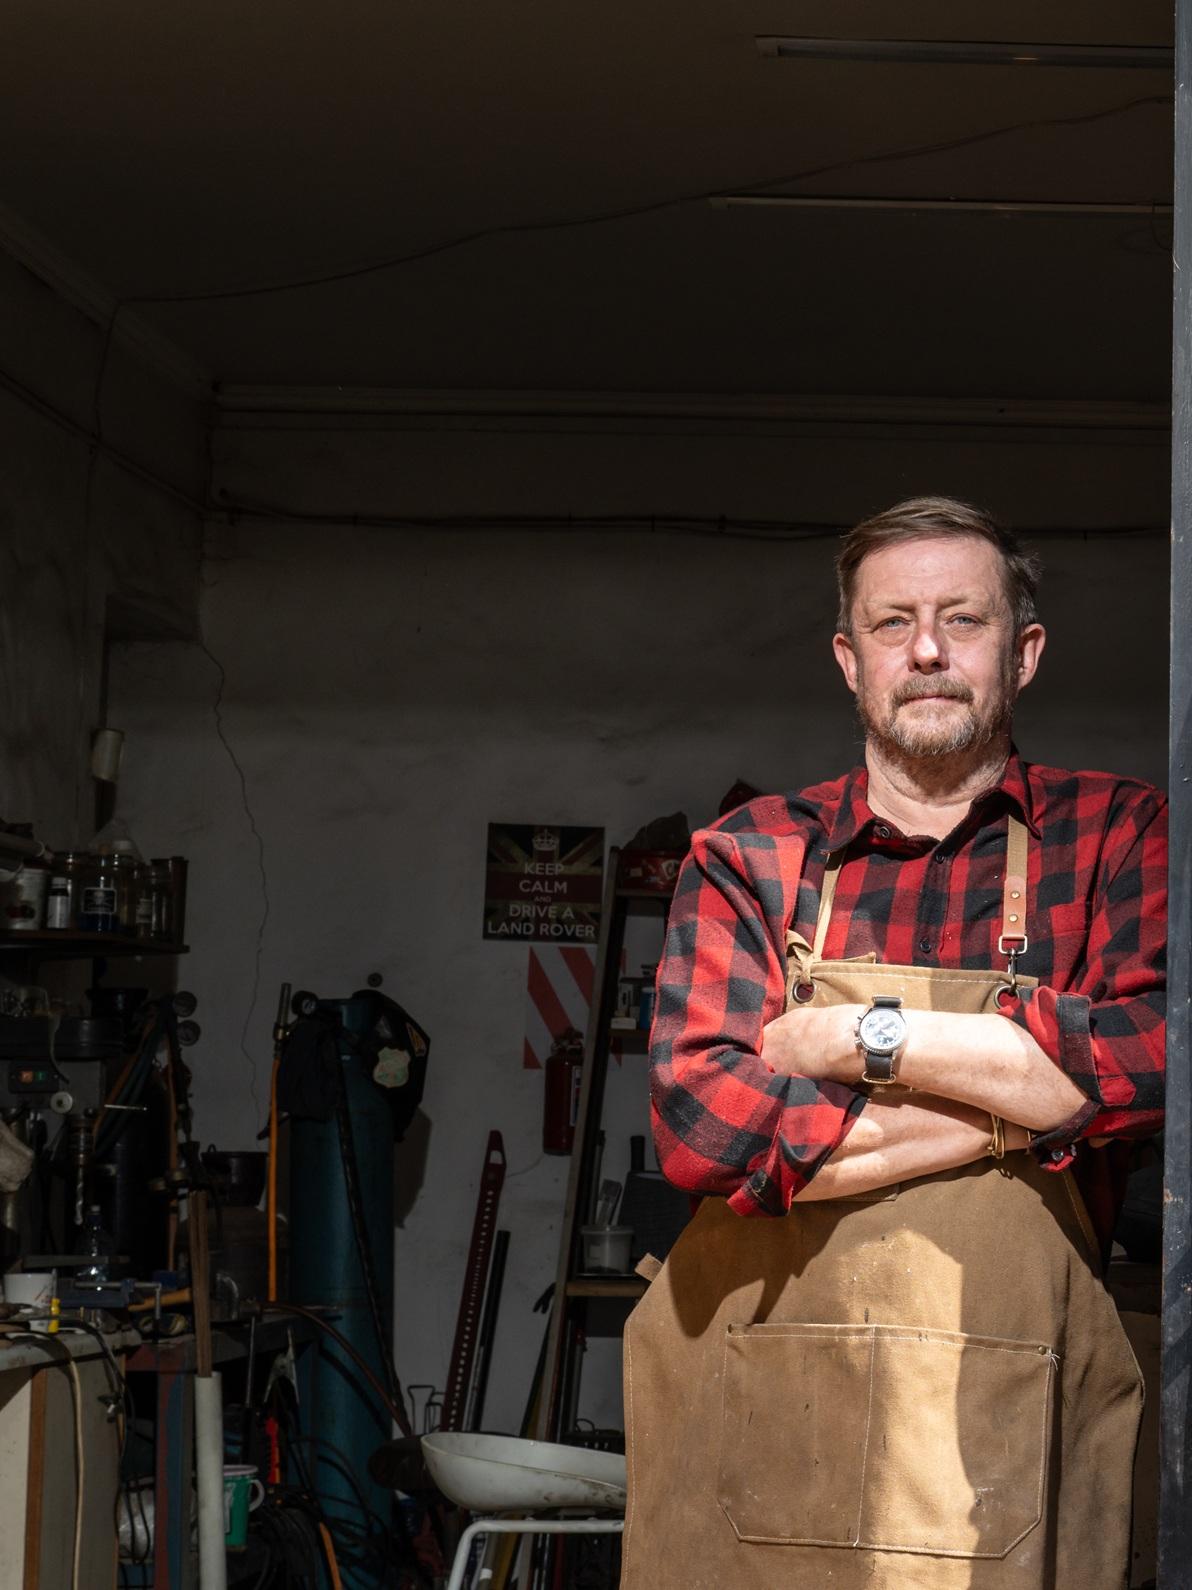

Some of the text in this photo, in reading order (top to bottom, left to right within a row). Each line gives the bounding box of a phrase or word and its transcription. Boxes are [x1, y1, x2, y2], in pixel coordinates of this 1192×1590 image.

[524, 862, 564, 875] KEEP
[519, 879, 567, 893] CALM
[534, 895, 552, 903] AND
[509, 904, 575, 920] DRIVE A
[487, 921, 595, 938] LAND ROVER
